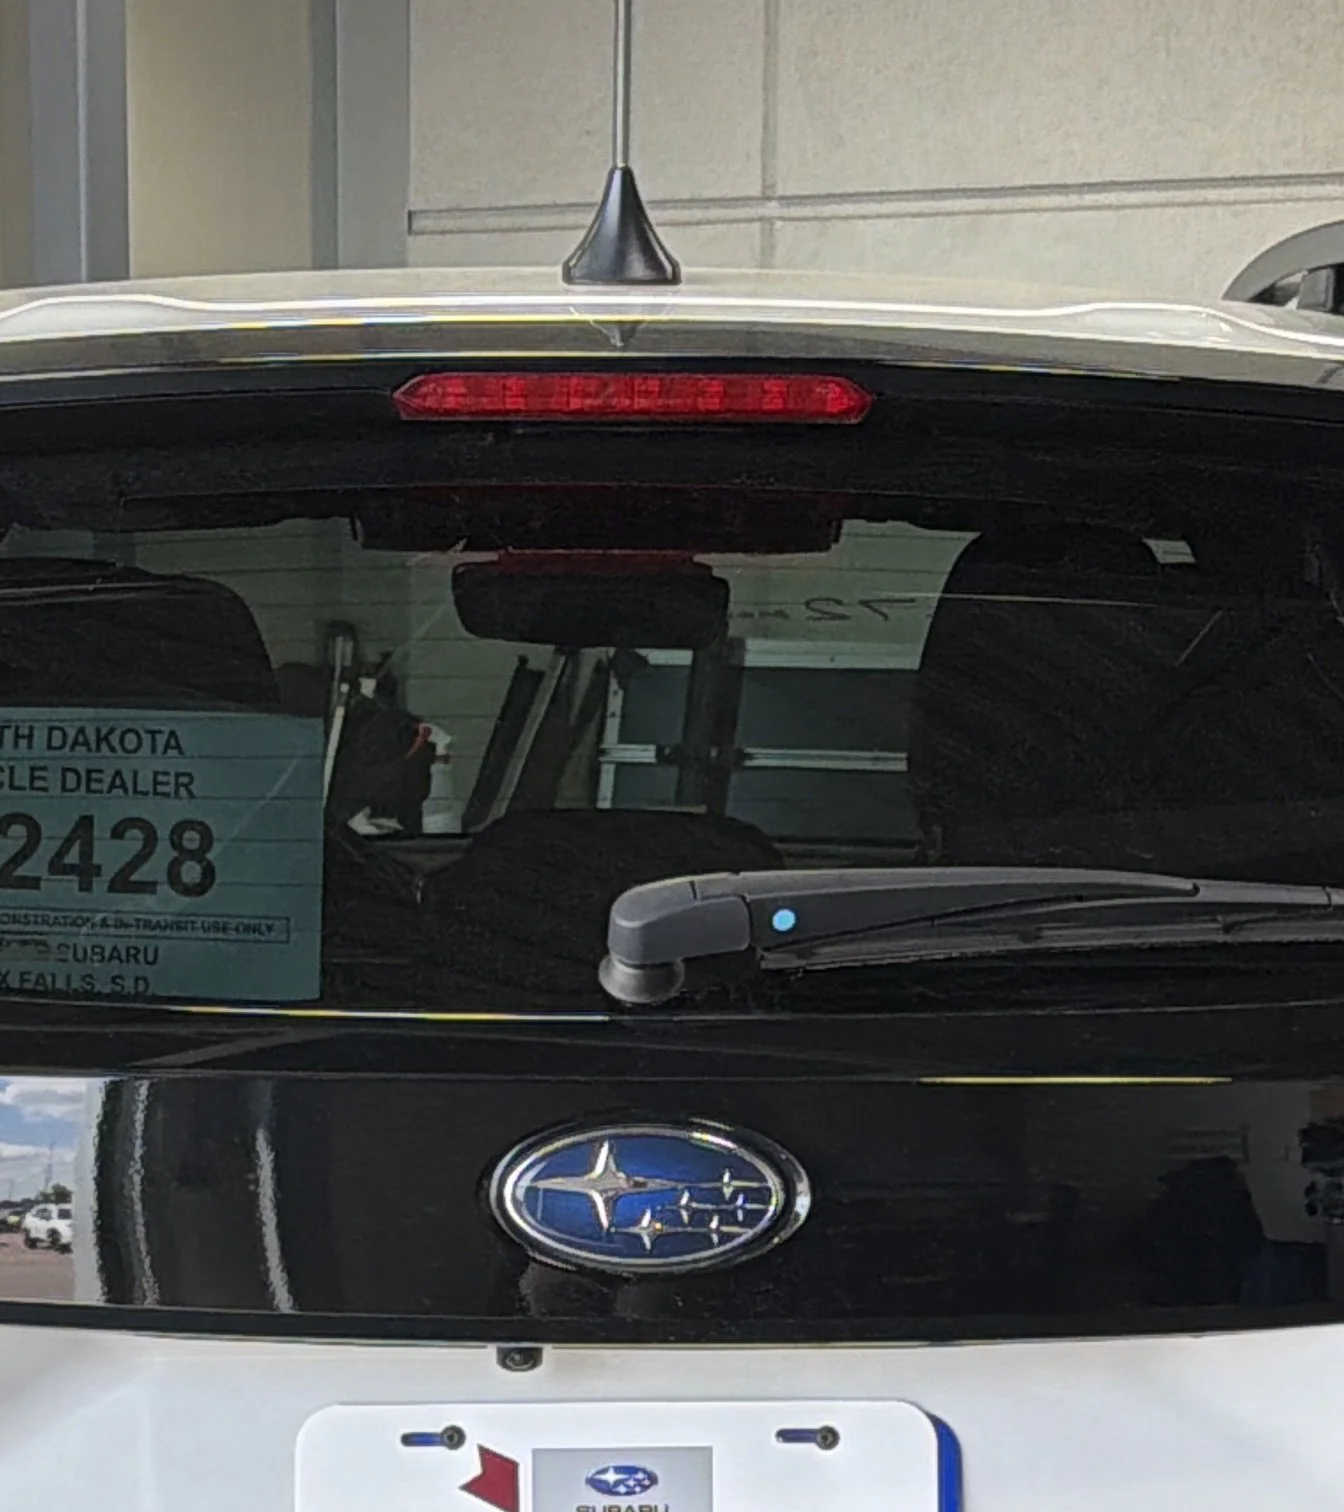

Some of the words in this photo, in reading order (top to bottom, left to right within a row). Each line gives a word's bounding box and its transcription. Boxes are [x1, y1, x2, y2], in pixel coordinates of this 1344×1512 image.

[45, 724, 185, 757] DAKOTA
[60, 766, 196, 800] DEALER
[234, 920, 275, 937] ONLY
